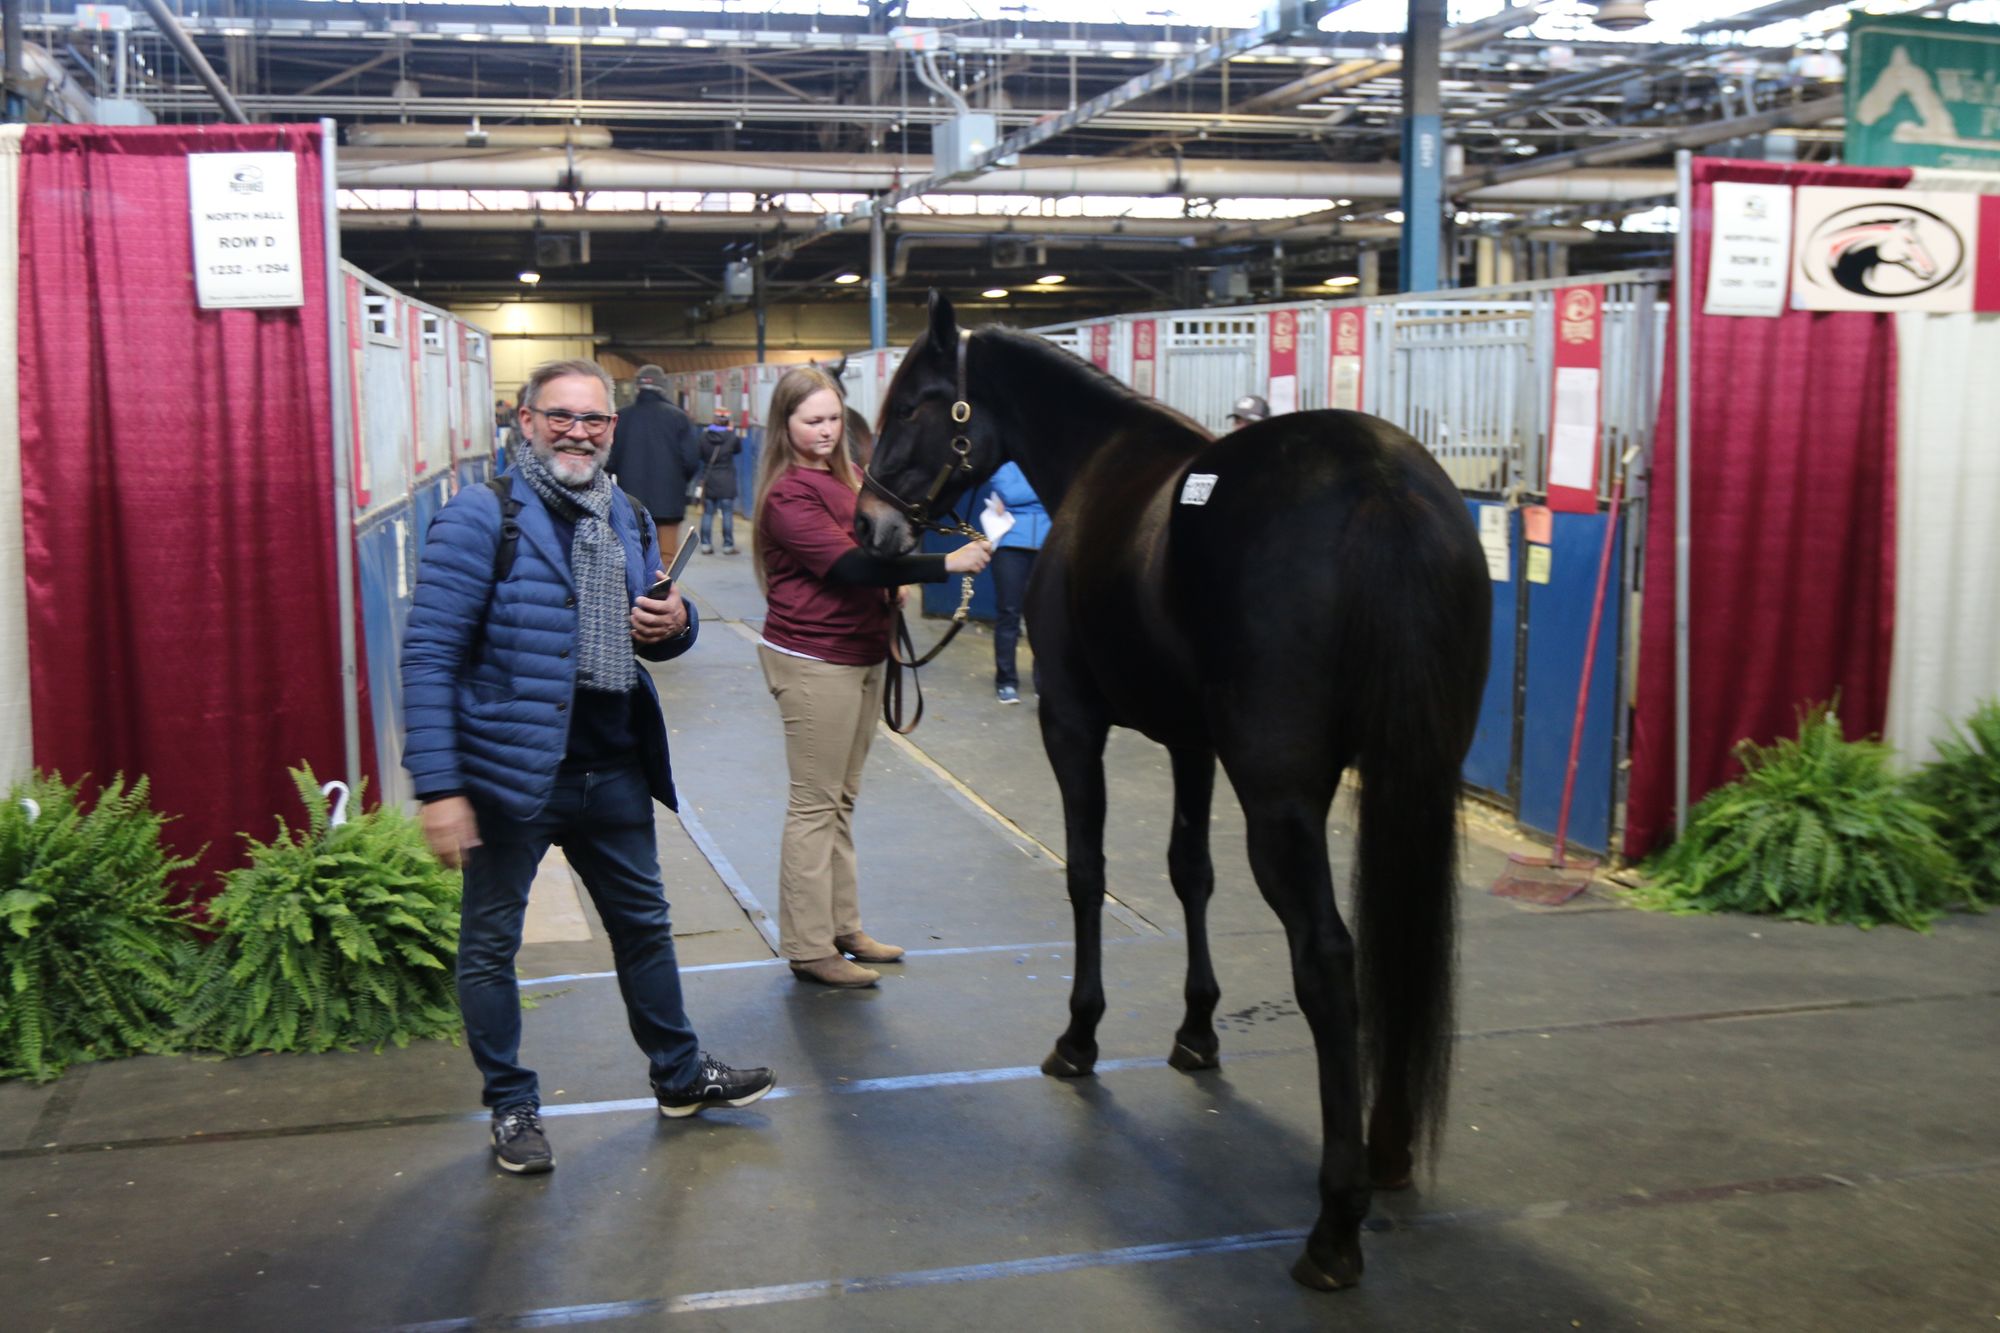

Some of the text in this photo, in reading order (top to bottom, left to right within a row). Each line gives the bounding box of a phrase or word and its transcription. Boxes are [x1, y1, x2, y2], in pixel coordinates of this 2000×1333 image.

[206, 211, 285, 222] NORTH HALL
[219, 235, 276, 249] ROW D
[208, 264, 242, 275] 1232
[256, 263, 290, 274] 1294
